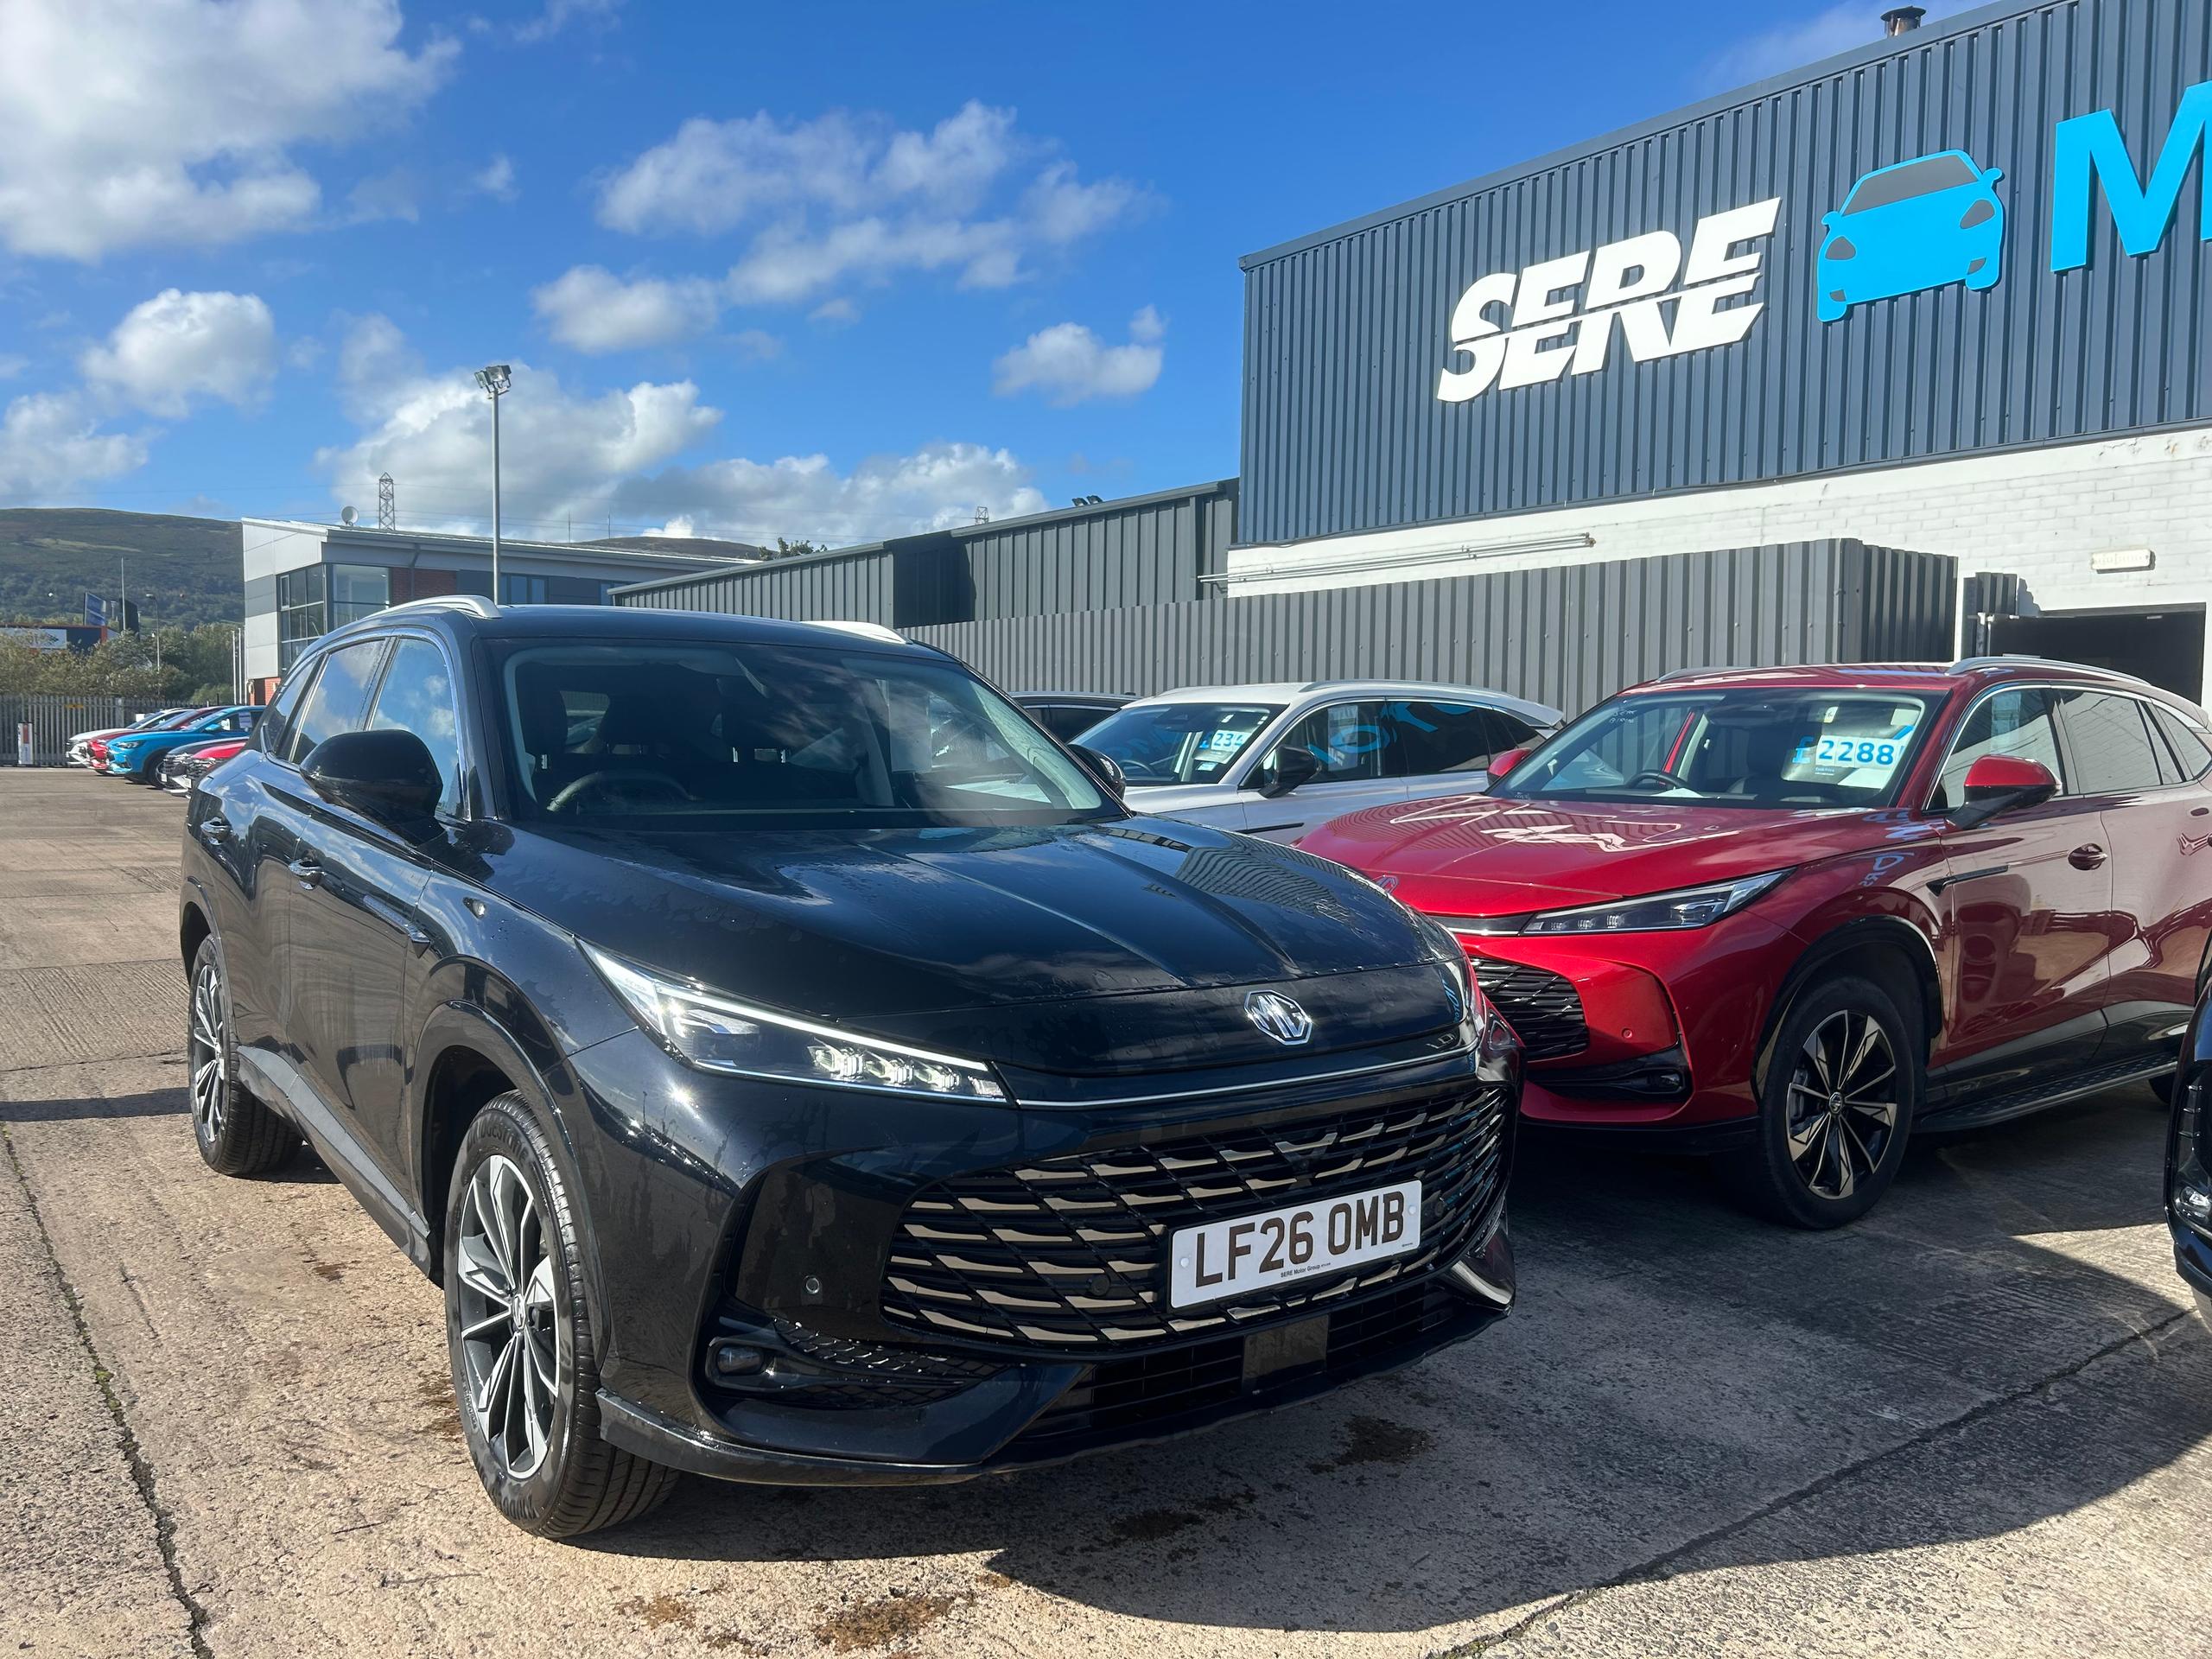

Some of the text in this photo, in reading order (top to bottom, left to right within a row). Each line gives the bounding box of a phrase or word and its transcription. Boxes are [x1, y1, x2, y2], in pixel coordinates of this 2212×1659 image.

[2050, 79, 2212, 272] M
[1437, 196, 1781, 403] SERE
[1249, 994, 1307, 1039] MG
[1195, 1191, 1405, 1288] LF26 OMB
